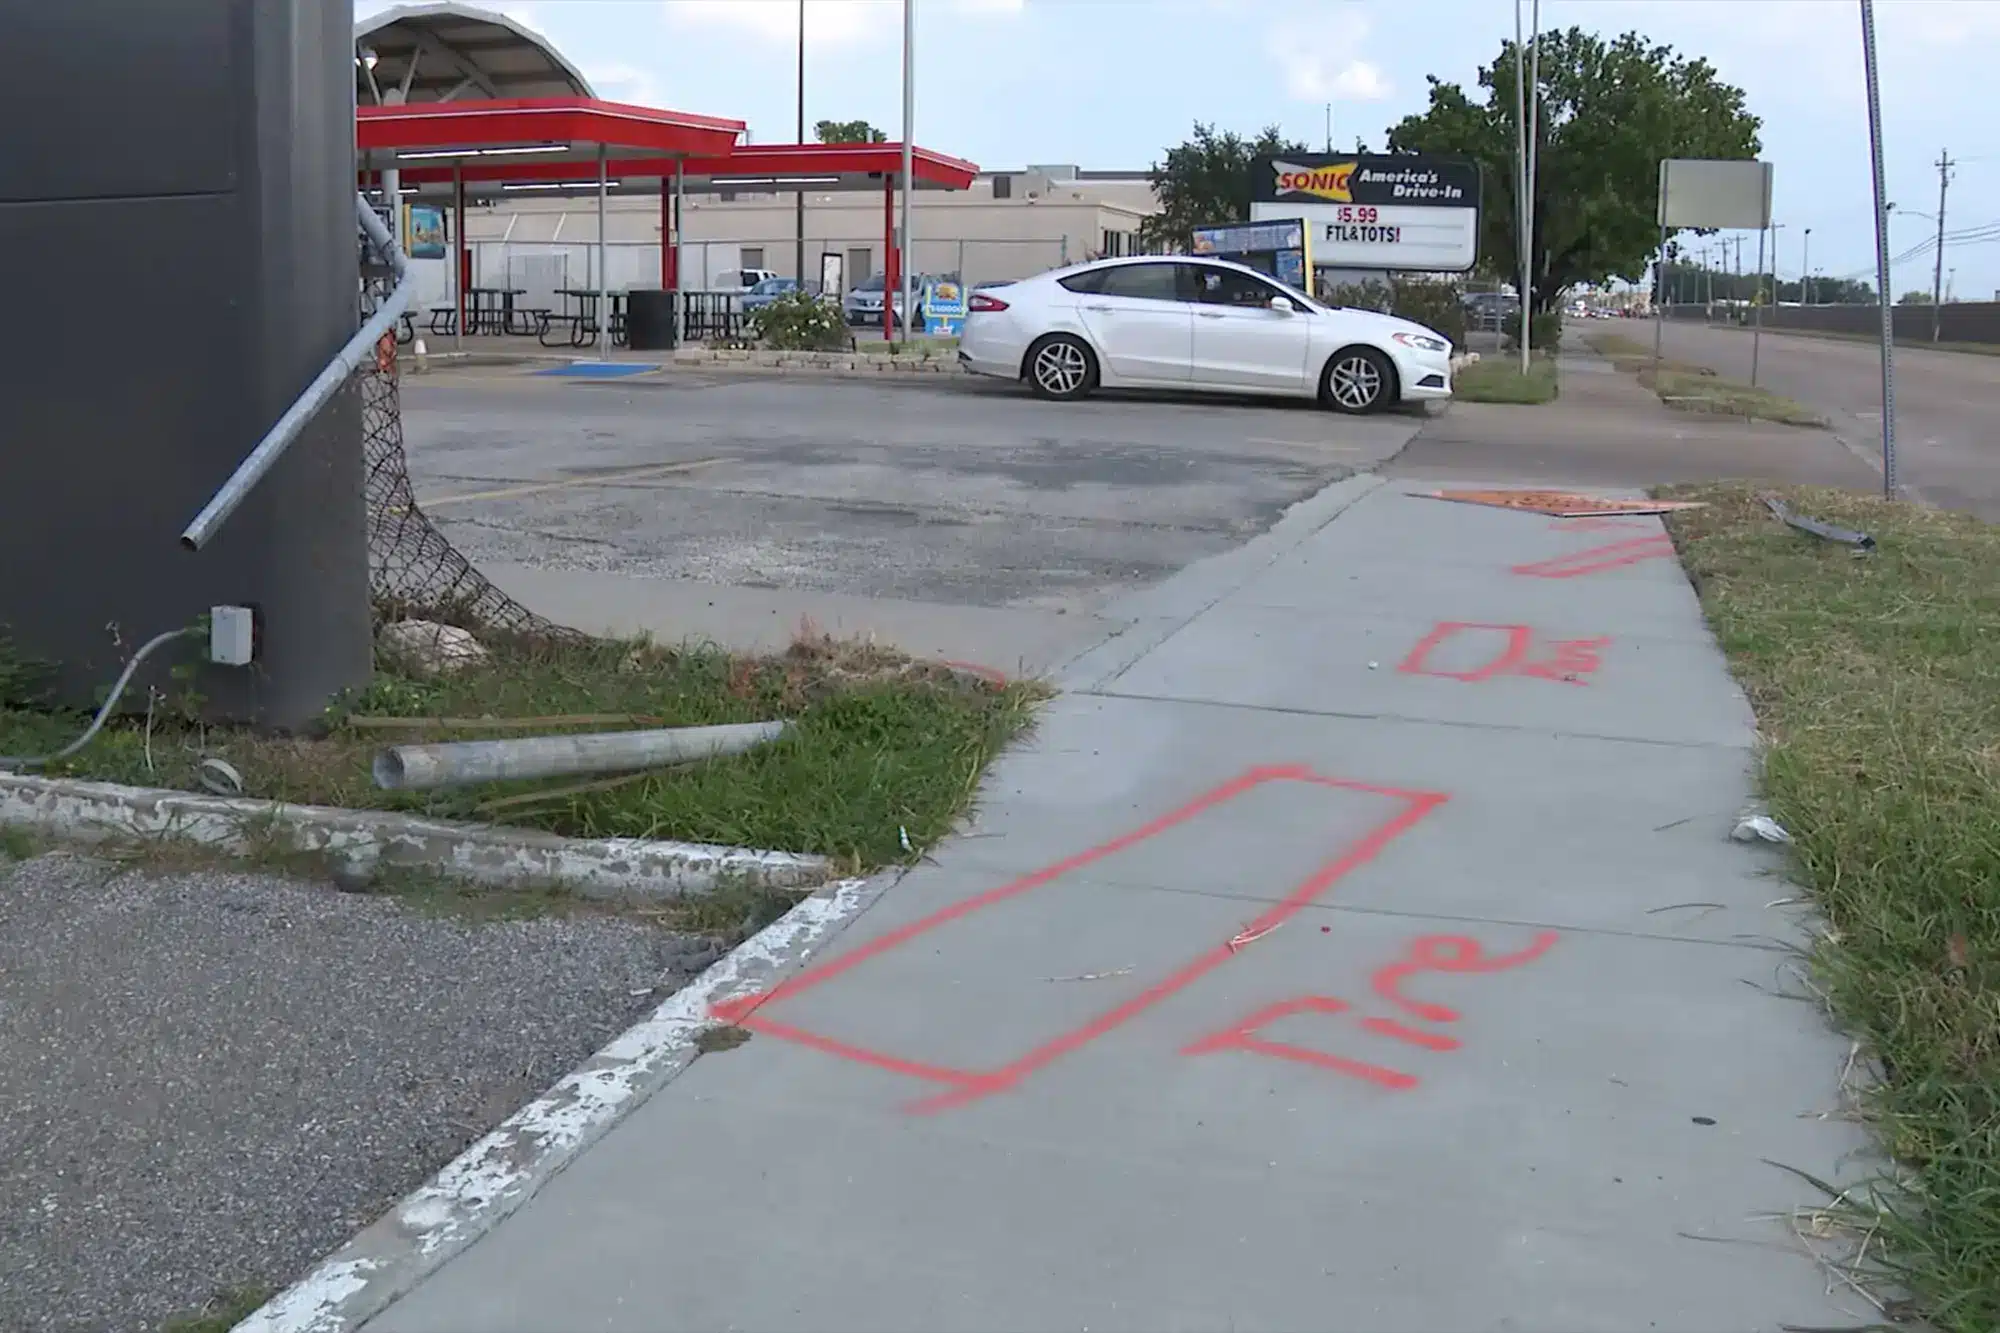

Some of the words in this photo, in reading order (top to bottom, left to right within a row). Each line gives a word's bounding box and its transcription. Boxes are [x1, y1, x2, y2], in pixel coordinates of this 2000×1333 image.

[1279, 172, 1351, 191] SONIC
[1359, 168, 1438, 183] America's
[1393, 183, 1462, 199] Drive-In
[1337, 207, 1378, 223] $5.99
[1326, 225, 1400, 242] FTL&TOTS!
